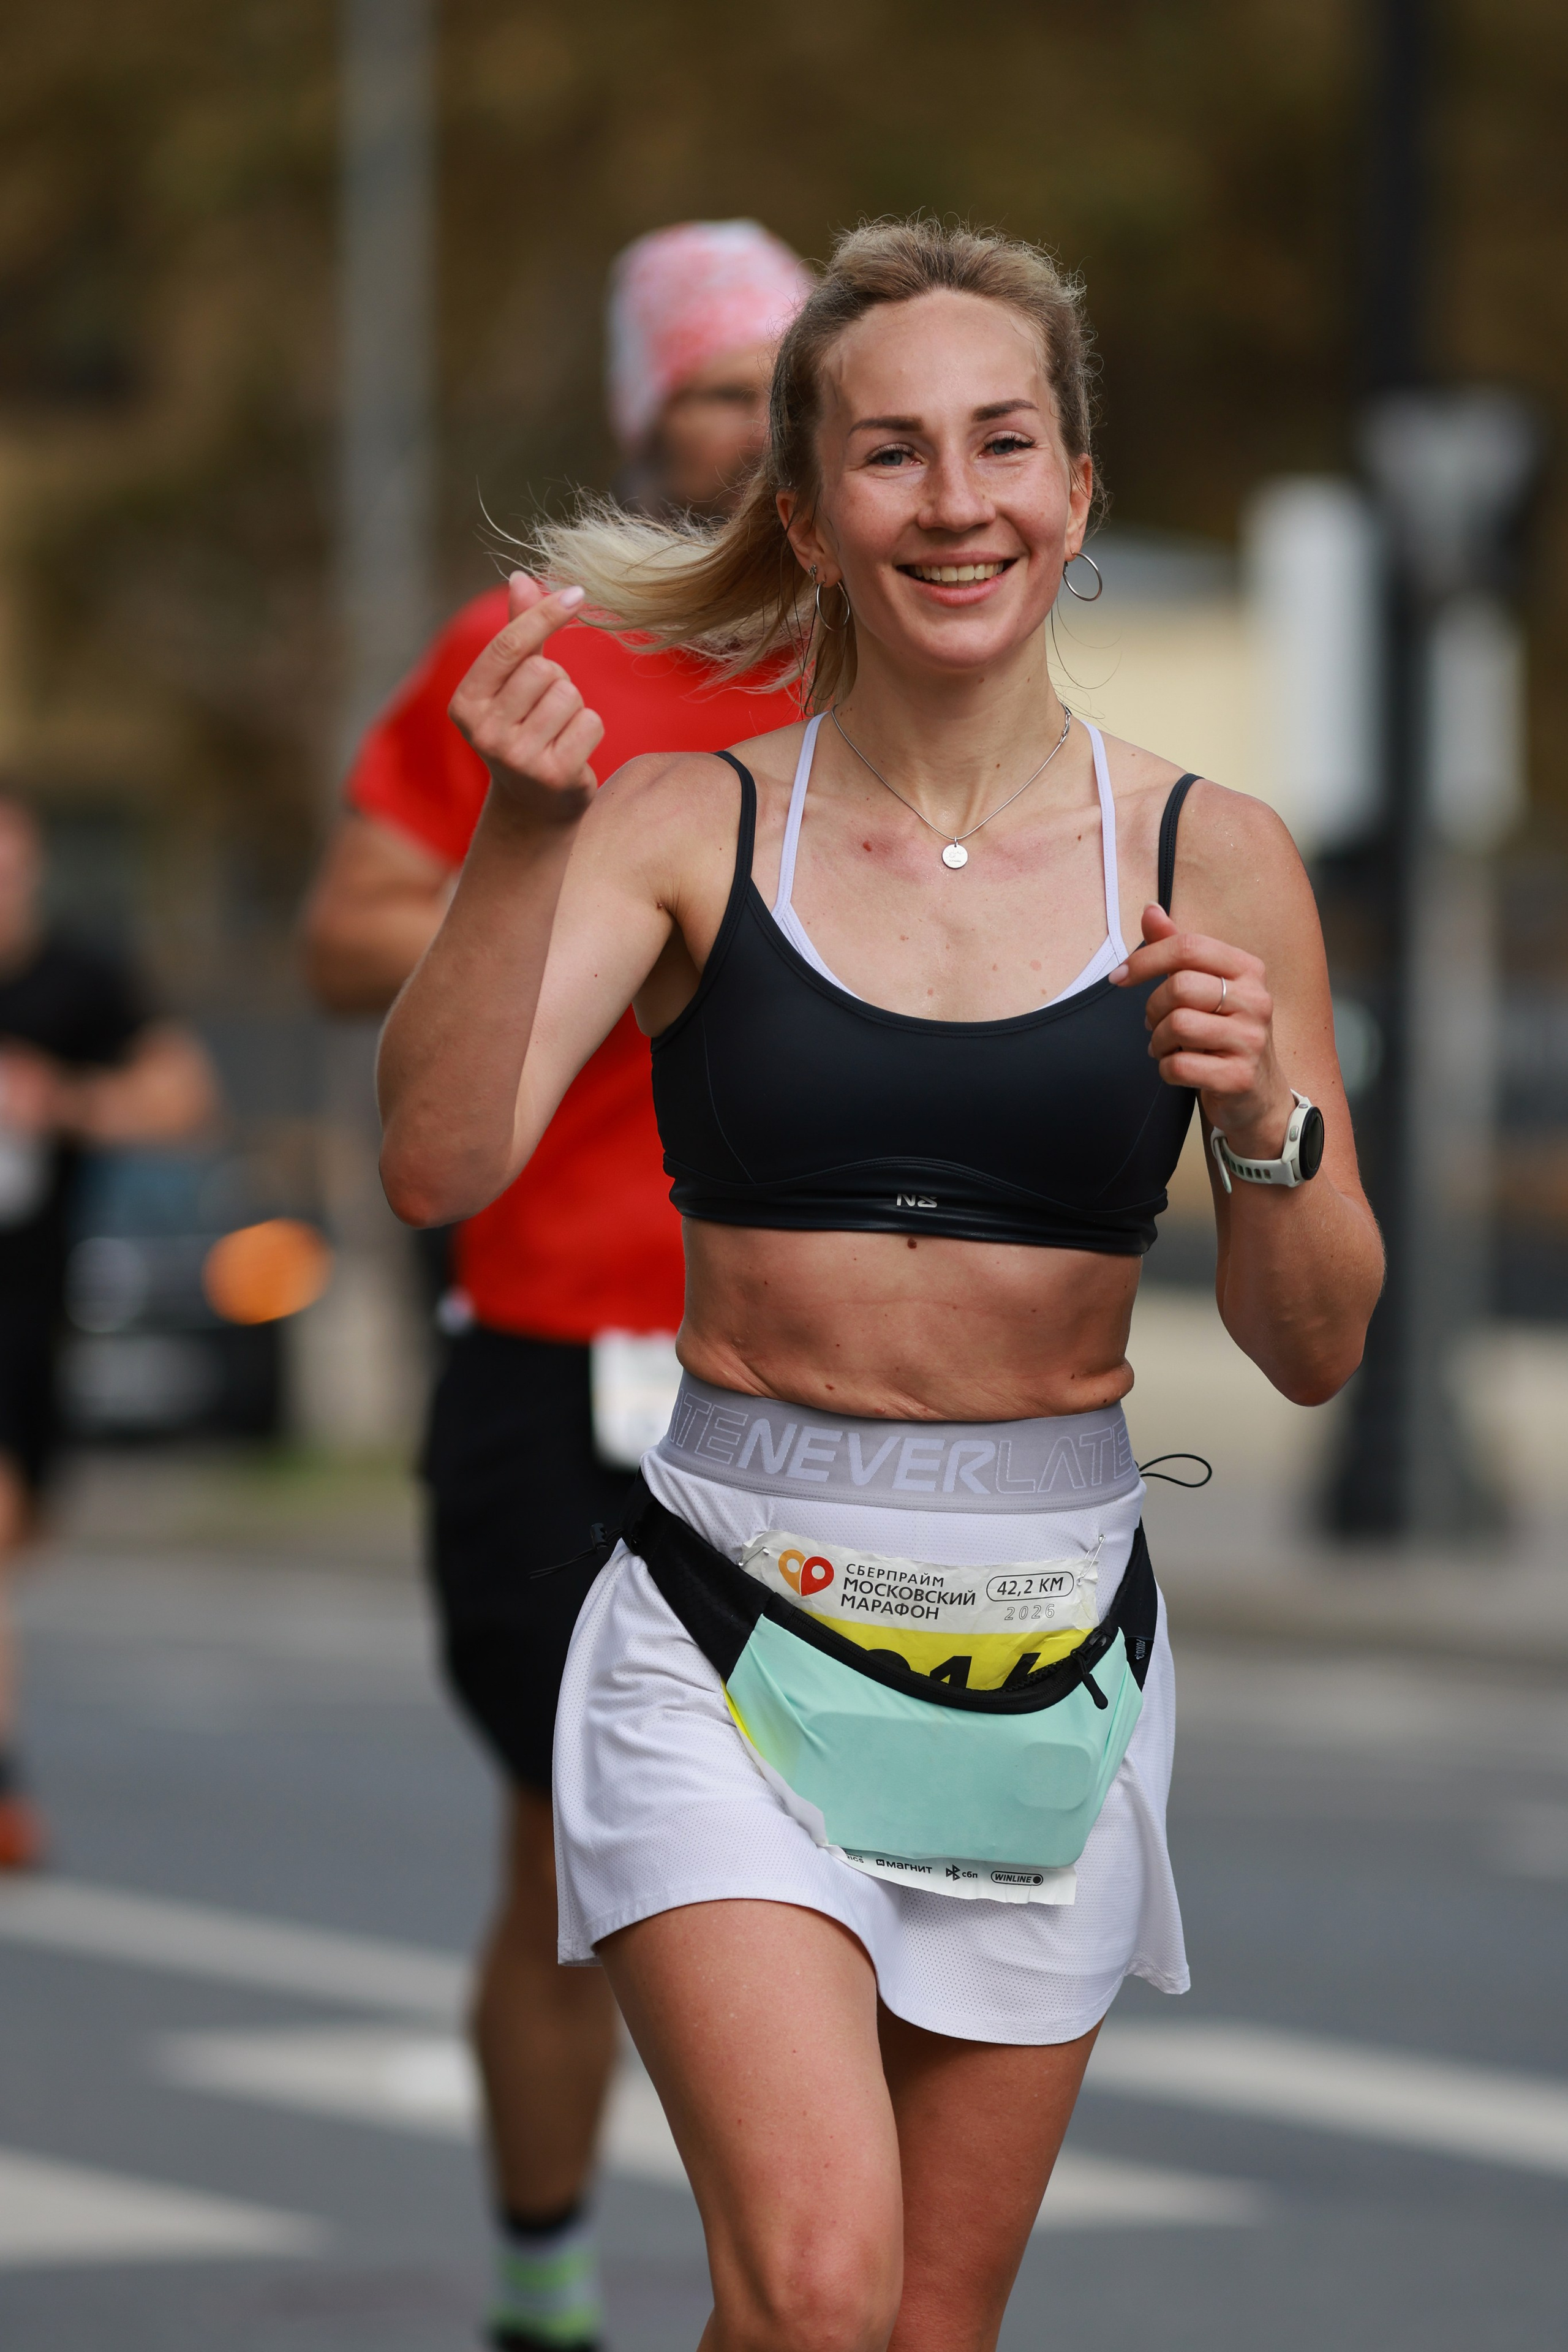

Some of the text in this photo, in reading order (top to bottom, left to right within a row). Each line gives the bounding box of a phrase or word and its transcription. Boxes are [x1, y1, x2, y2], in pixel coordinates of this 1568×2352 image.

[846, 1563, 944, 1588] СБЕРПРАЙМ
[843, 1577, 976, 1605] МОСКОВСКИЙ
[997, 1577, 1064, 1597] 42,2 КМ
[840, 1593, 940, 1620] МАРАФОН
[1004, 1604, 1055, 1621] 2026
[994, 1873, 1033, 1883] WINLINE
